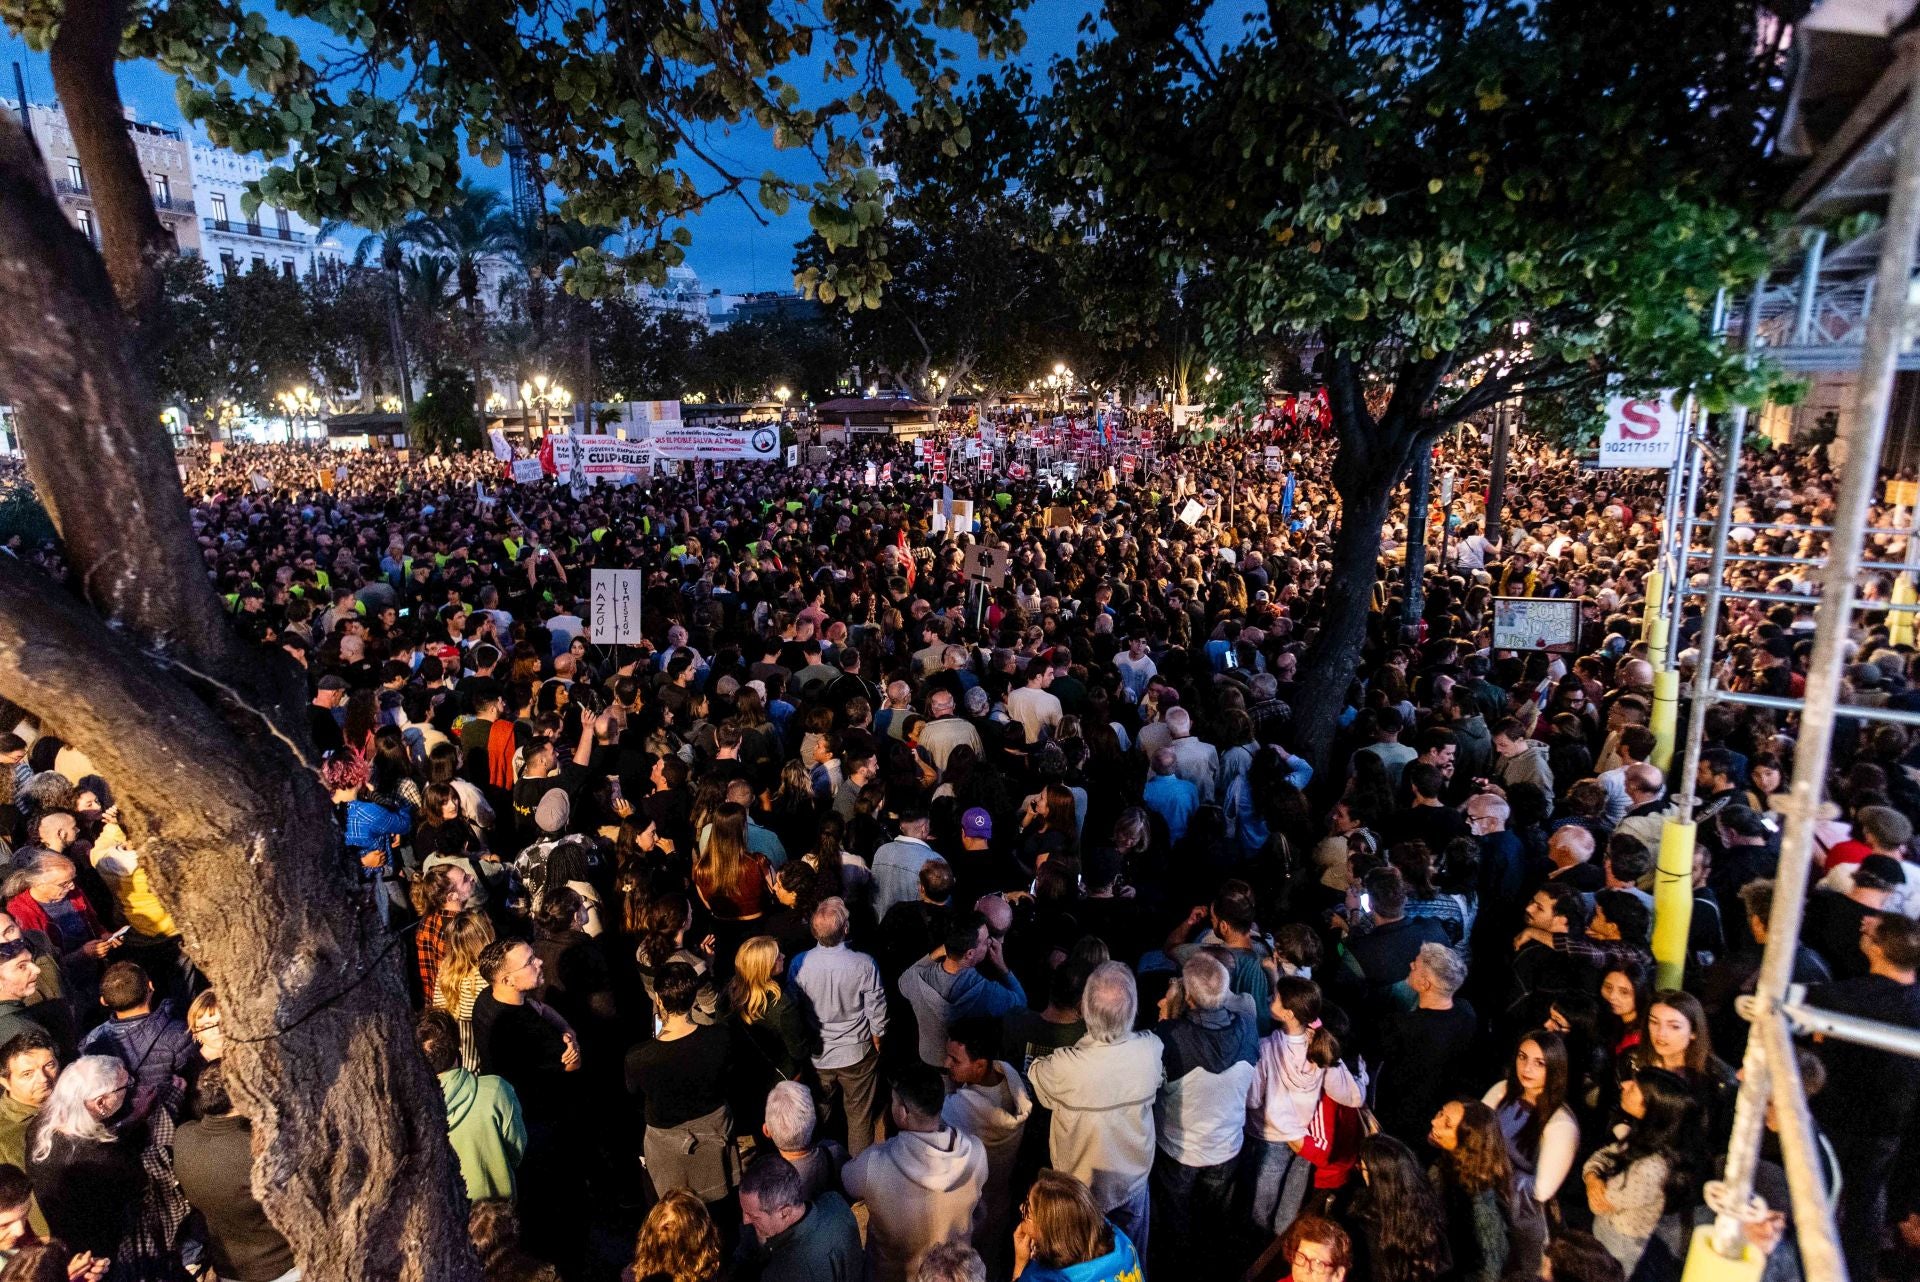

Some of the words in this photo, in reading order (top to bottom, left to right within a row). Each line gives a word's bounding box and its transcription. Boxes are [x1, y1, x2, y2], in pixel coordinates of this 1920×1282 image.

[1619, 398, 1661, 440] S
[588, 453, 650, 464] CULPABLES!
[1606, 443, 1670, 453] 902171517
[596, 582, 606, 637] MAZÓN
